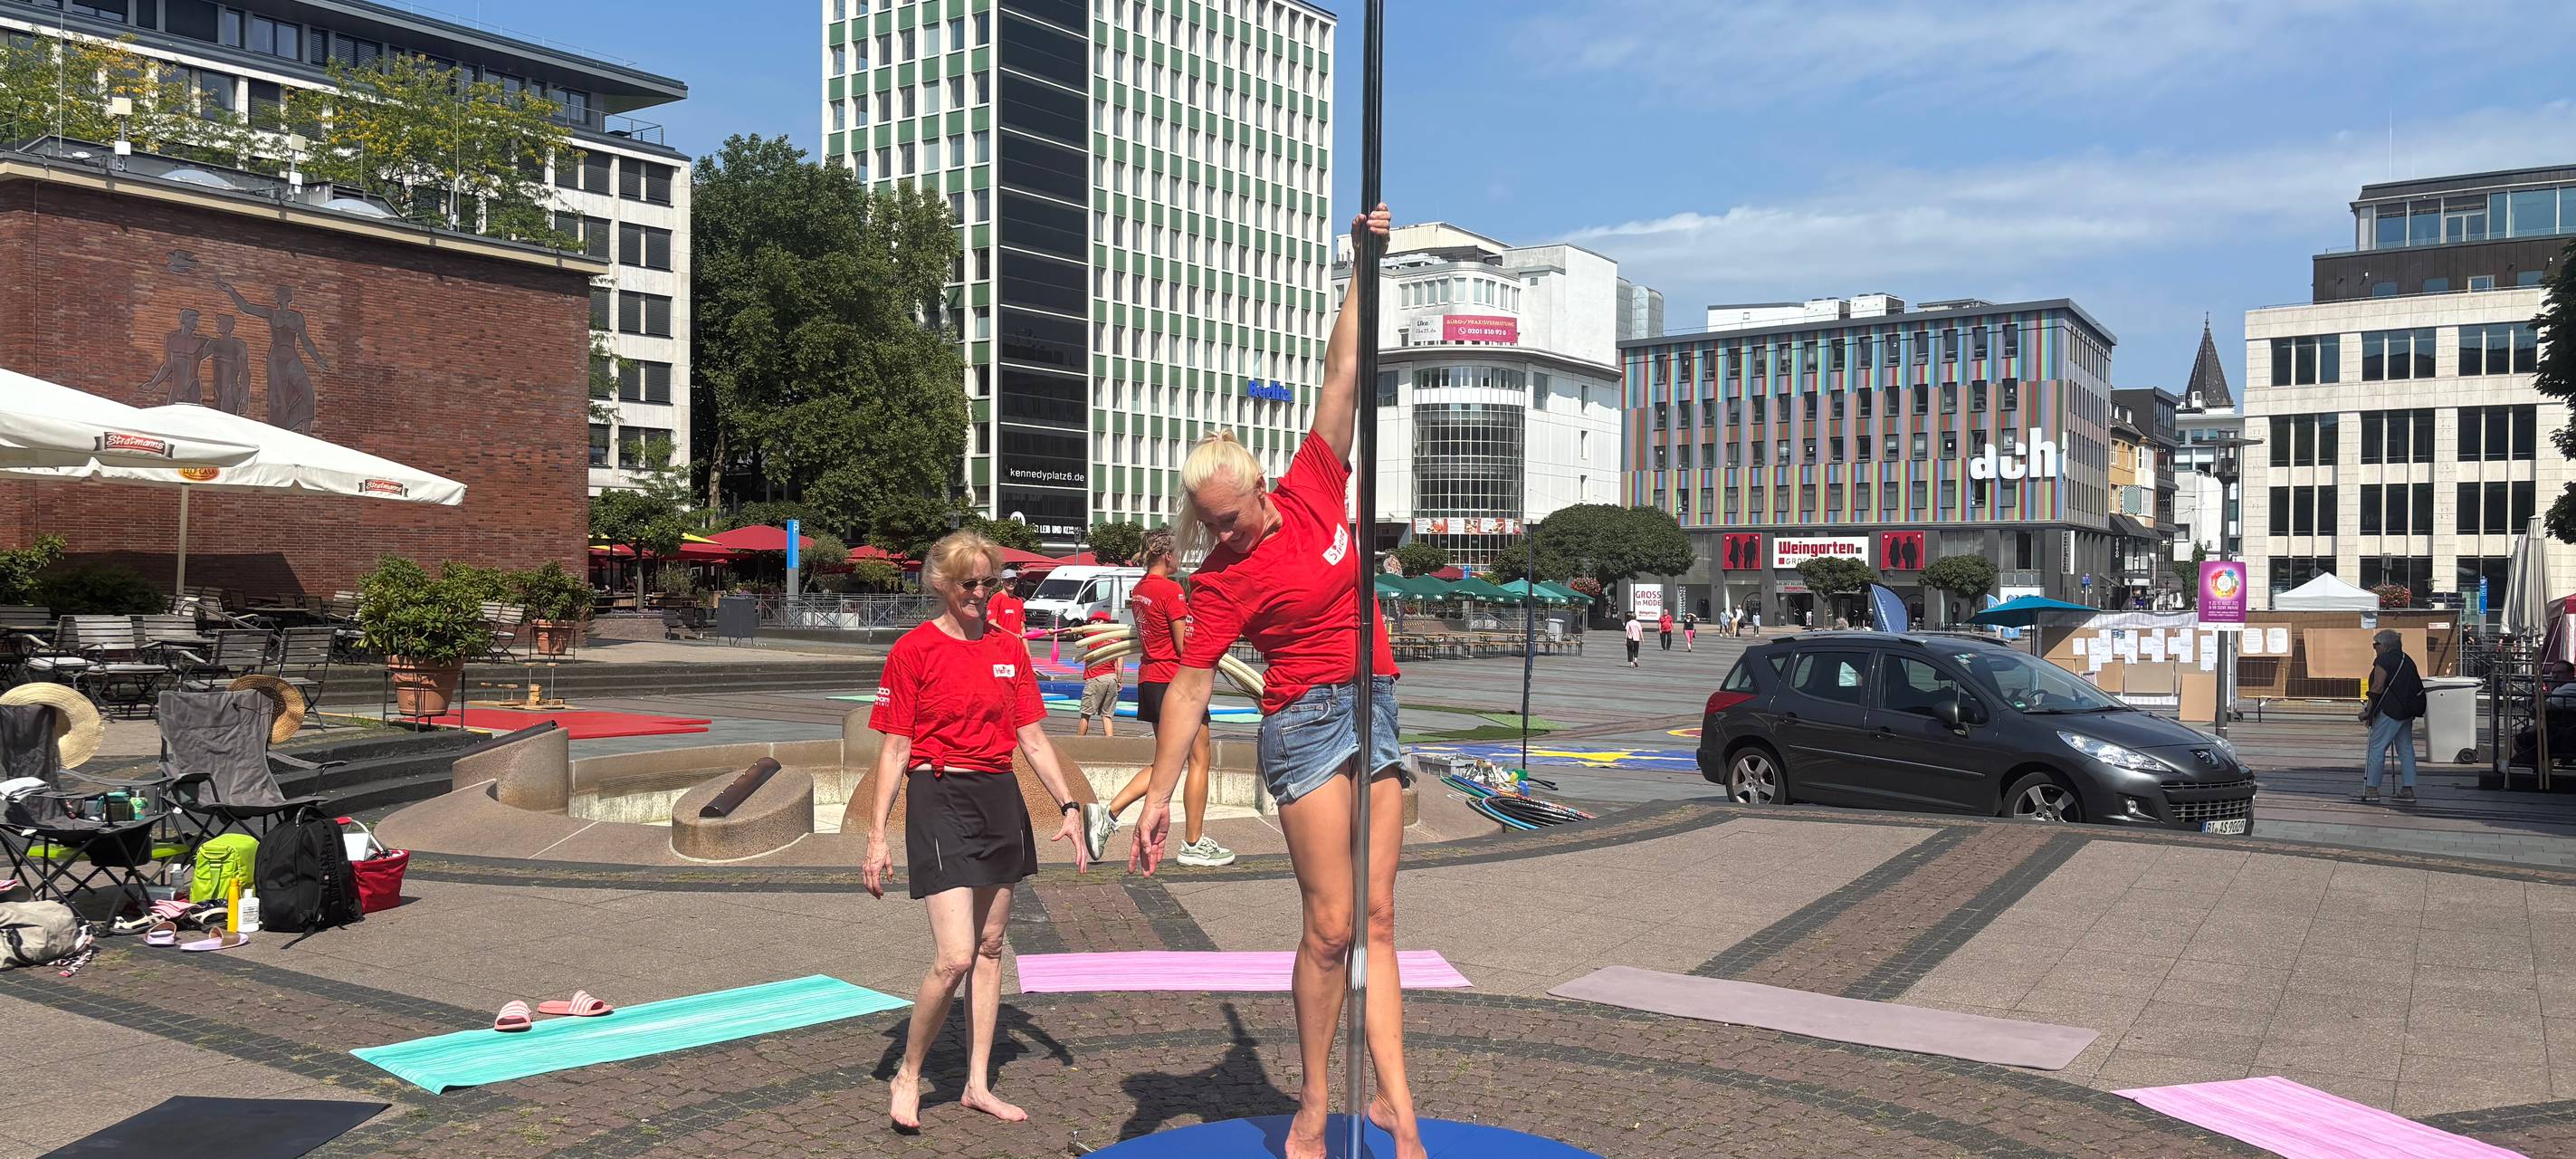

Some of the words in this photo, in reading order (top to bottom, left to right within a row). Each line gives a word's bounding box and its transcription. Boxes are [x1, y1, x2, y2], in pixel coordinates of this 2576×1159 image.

[105, 435, 165, 451] Stratmanns
[1009, 467, 1085, 482] kennedyplatz6.de
[1778, 541, 1855, 557] Weingarten
[1635, 590, 1662, 599] GROSS
